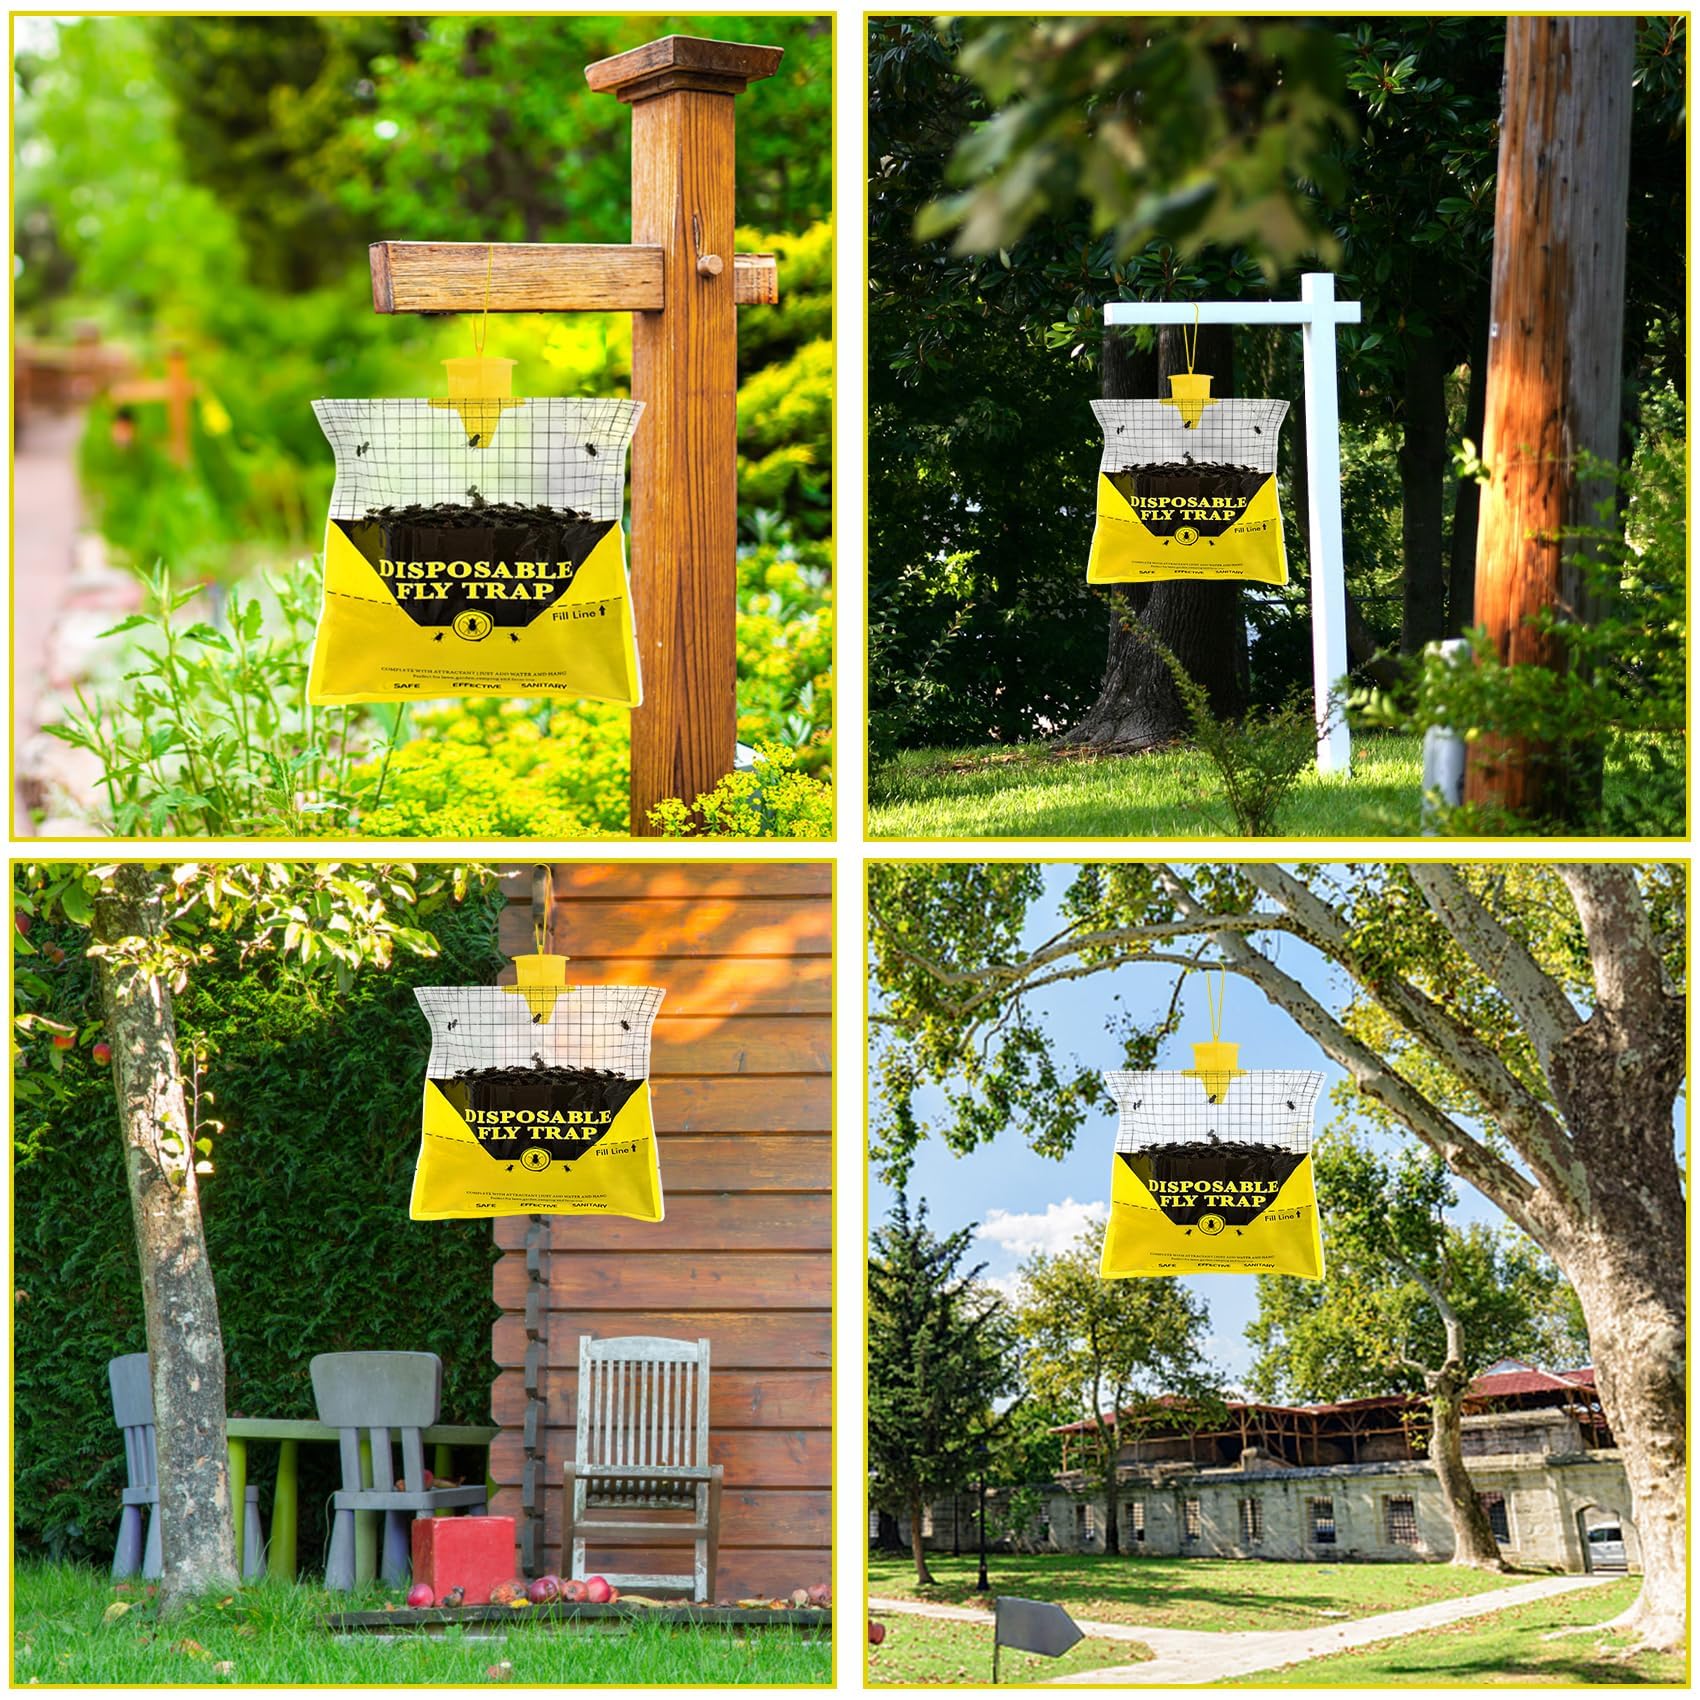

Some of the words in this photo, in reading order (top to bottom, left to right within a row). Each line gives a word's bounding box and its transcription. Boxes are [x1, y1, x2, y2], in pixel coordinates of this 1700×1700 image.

[1130, 496, 1247, 508] DISPOSABLE
[1140, 510, 1175, 520] FLY
[1180, 510, 1236, 520] TRAP
[379, 559, 574, 579] DISPOSABLE
[396, 582, 453, 600] FLY
[461, 582, 554, 600] TRAP
[552, 611, 569, 622] Fill
[572, 610, 596, 620] Line
[464, 1108, 612, 1124] DISPOSABLE
[478, 1126, 521, 1140] FLY
[527, 1126, 598, 1140] TRAP
[595, 1148, 609, 1157] Fill
[1149, 1179, 1279, 1193] DISPOSABLE
[1159, 1195, 1199, 1207] FLY
[1204, 1195, 1267, 1207] TRAP
